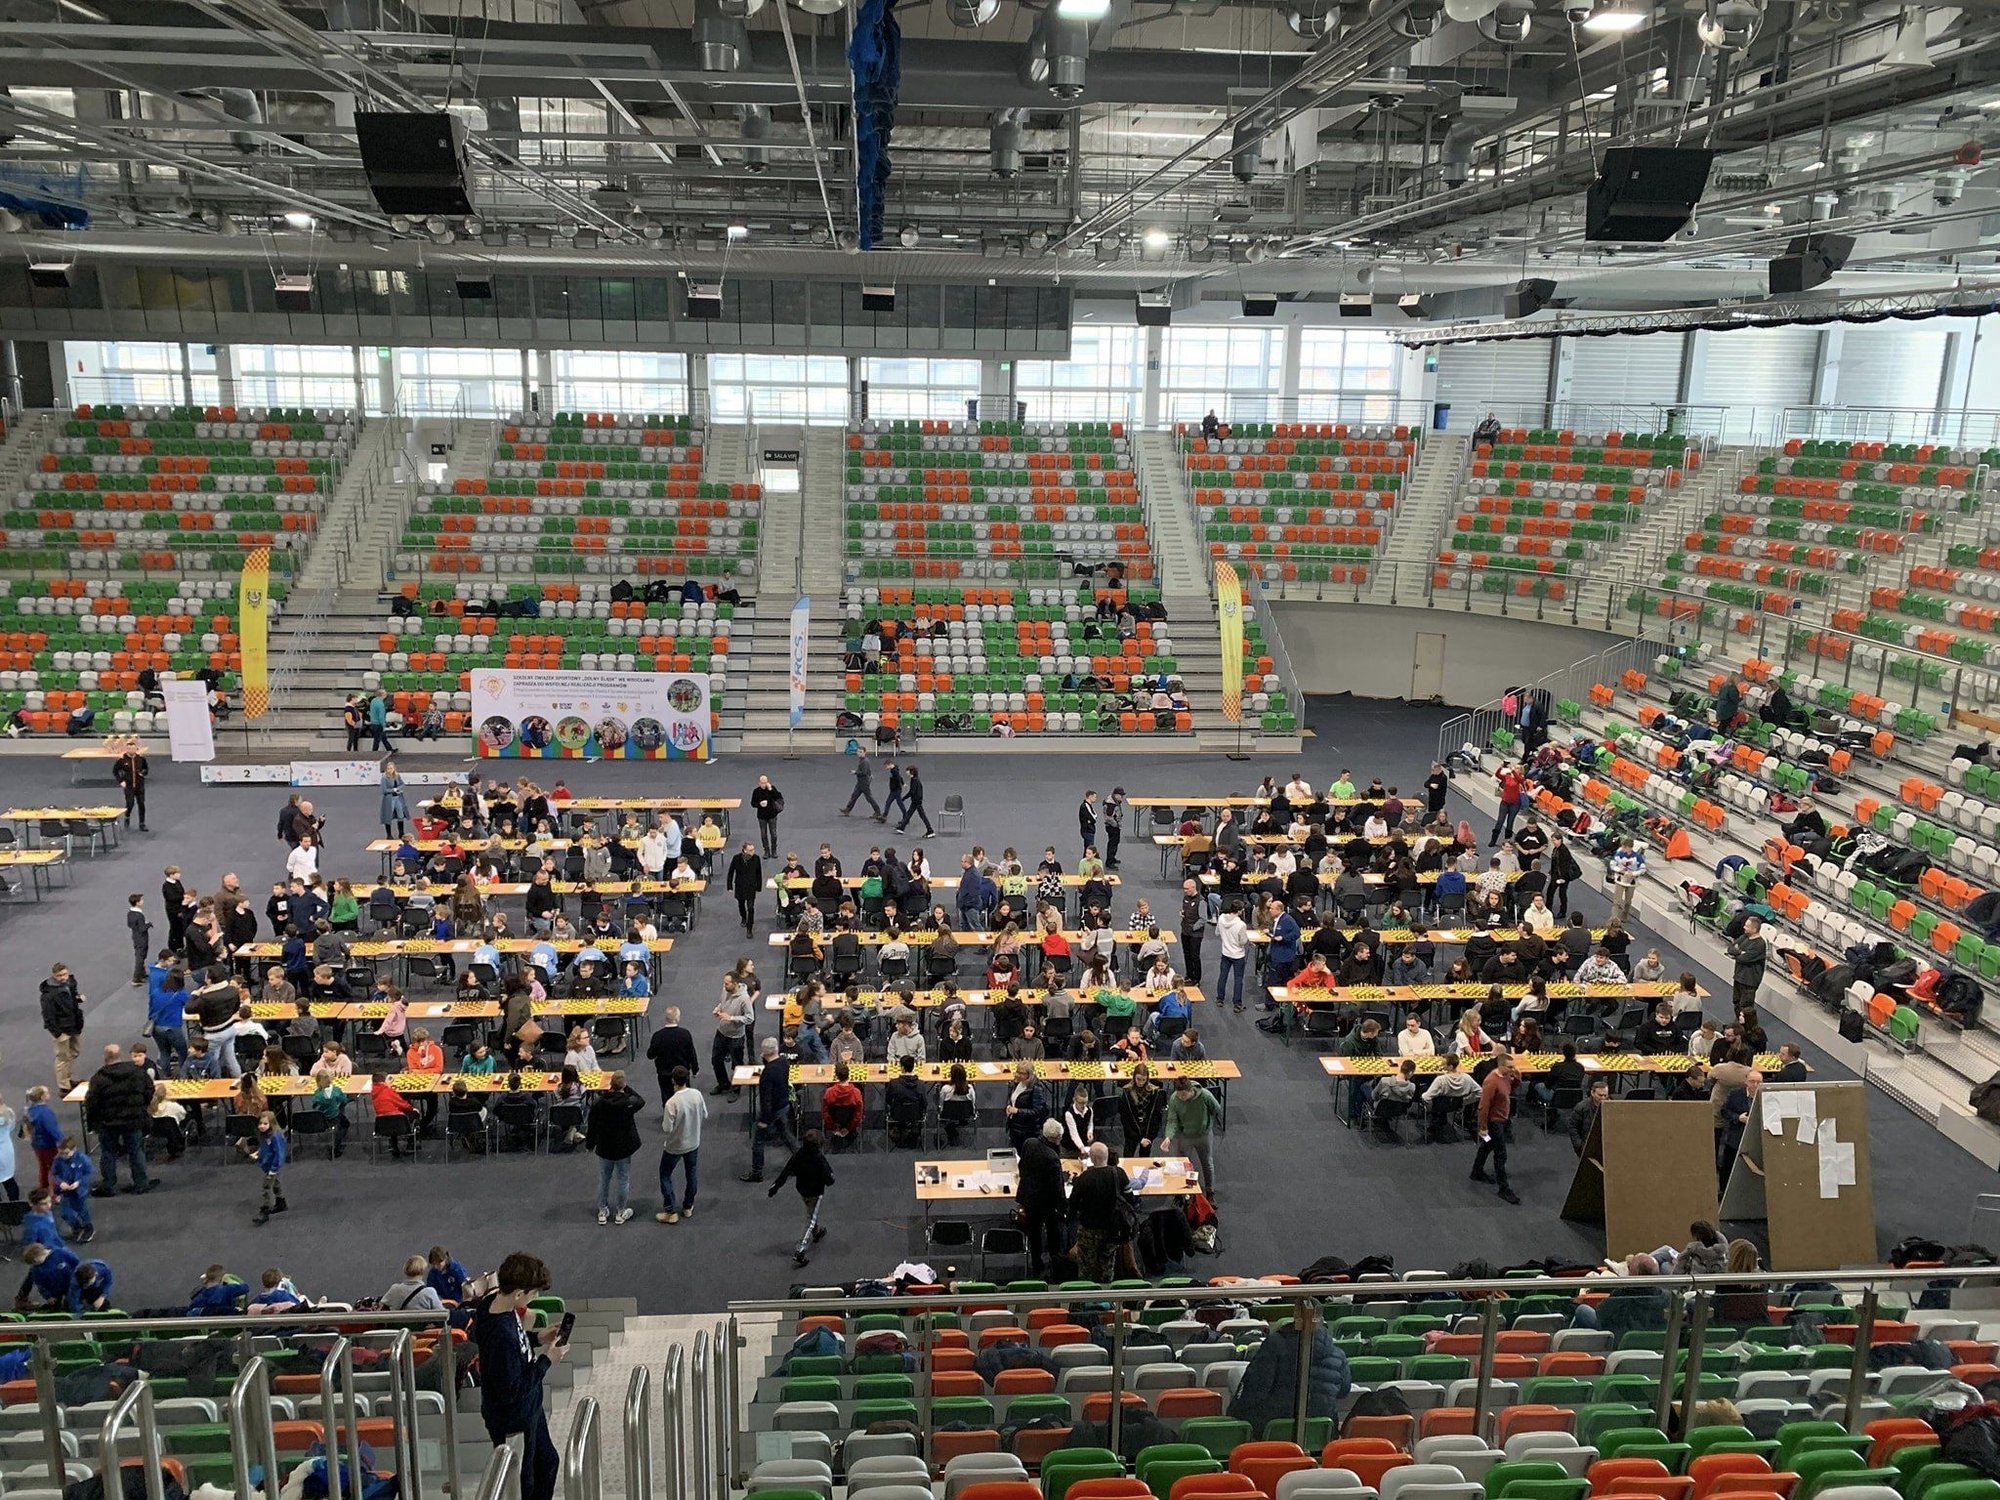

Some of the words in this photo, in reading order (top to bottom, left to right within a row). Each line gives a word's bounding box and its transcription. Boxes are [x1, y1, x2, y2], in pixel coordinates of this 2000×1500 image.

[794, 635, 803, 675] RCS
[243, 769, 251, 778] 2
[334, 769, 339, 779] 1
[422, 774, 429, 783] 3
